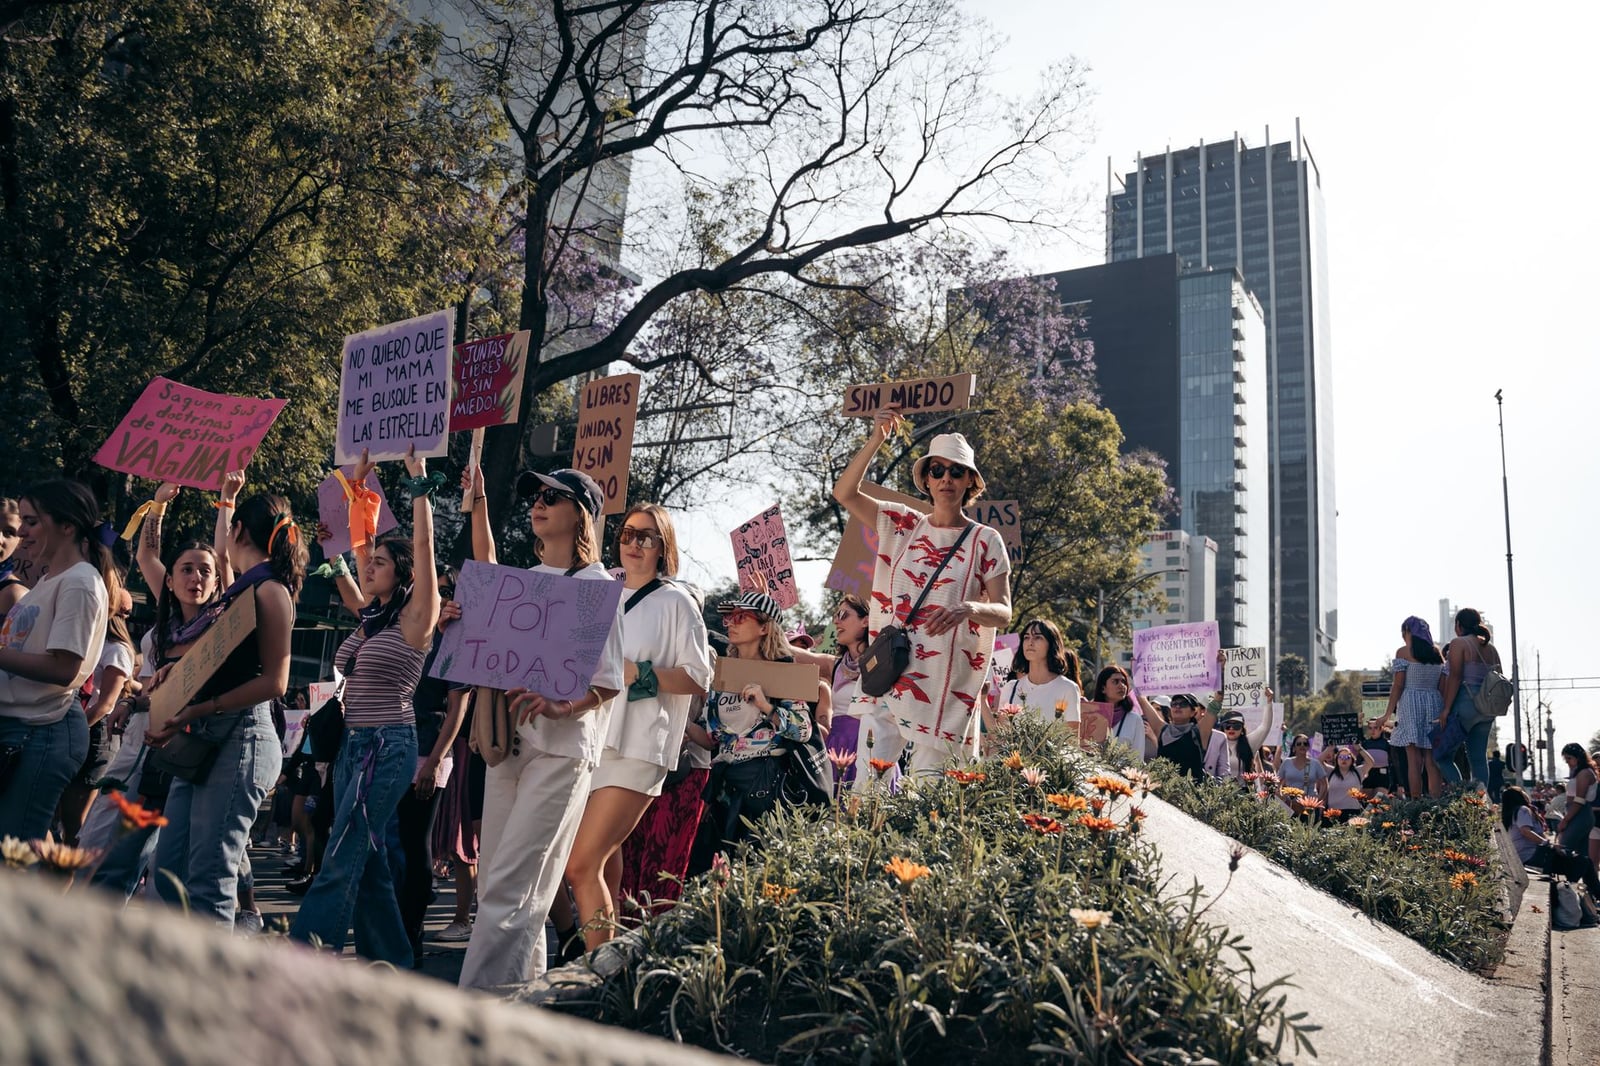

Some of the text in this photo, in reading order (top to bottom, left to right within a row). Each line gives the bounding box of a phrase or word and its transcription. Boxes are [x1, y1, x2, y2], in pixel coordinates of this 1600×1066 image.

[349, 328, 445, 369] NO QUIERO QUE
[359, 353, 434, 390] MI MAMÁ
[461, 358, 501, 379] LIBRES
[159, 383, 222, 411] Saquen
[346, 380, 447, 417] ME BUSQUE EN
[462, 376, 493, 397] Y SIN
[586, 382, 632, 409] LIBRES
[847, 381, 954, 412] SIN MIEDO
[454, 392, 497, 417] MIEDO!
[130, 414, 235, 443] de nuestras
[156, 405, 233, 430] doctrinas
[353, 411, 445, 443] LAS ESTRELLAS
[579, 417, 622, 440] UNIDAS
[1138, 631, 1160, 643] Nada
[1178, 628, 1200, 639] toca
[1204, 626, 1216, 638] sin
[1151, 637, 1207, 652] CONSENTIMIENTO
[1231, 664, 1257, 678] QUE
[725, 704, 742, 713] PARIS
